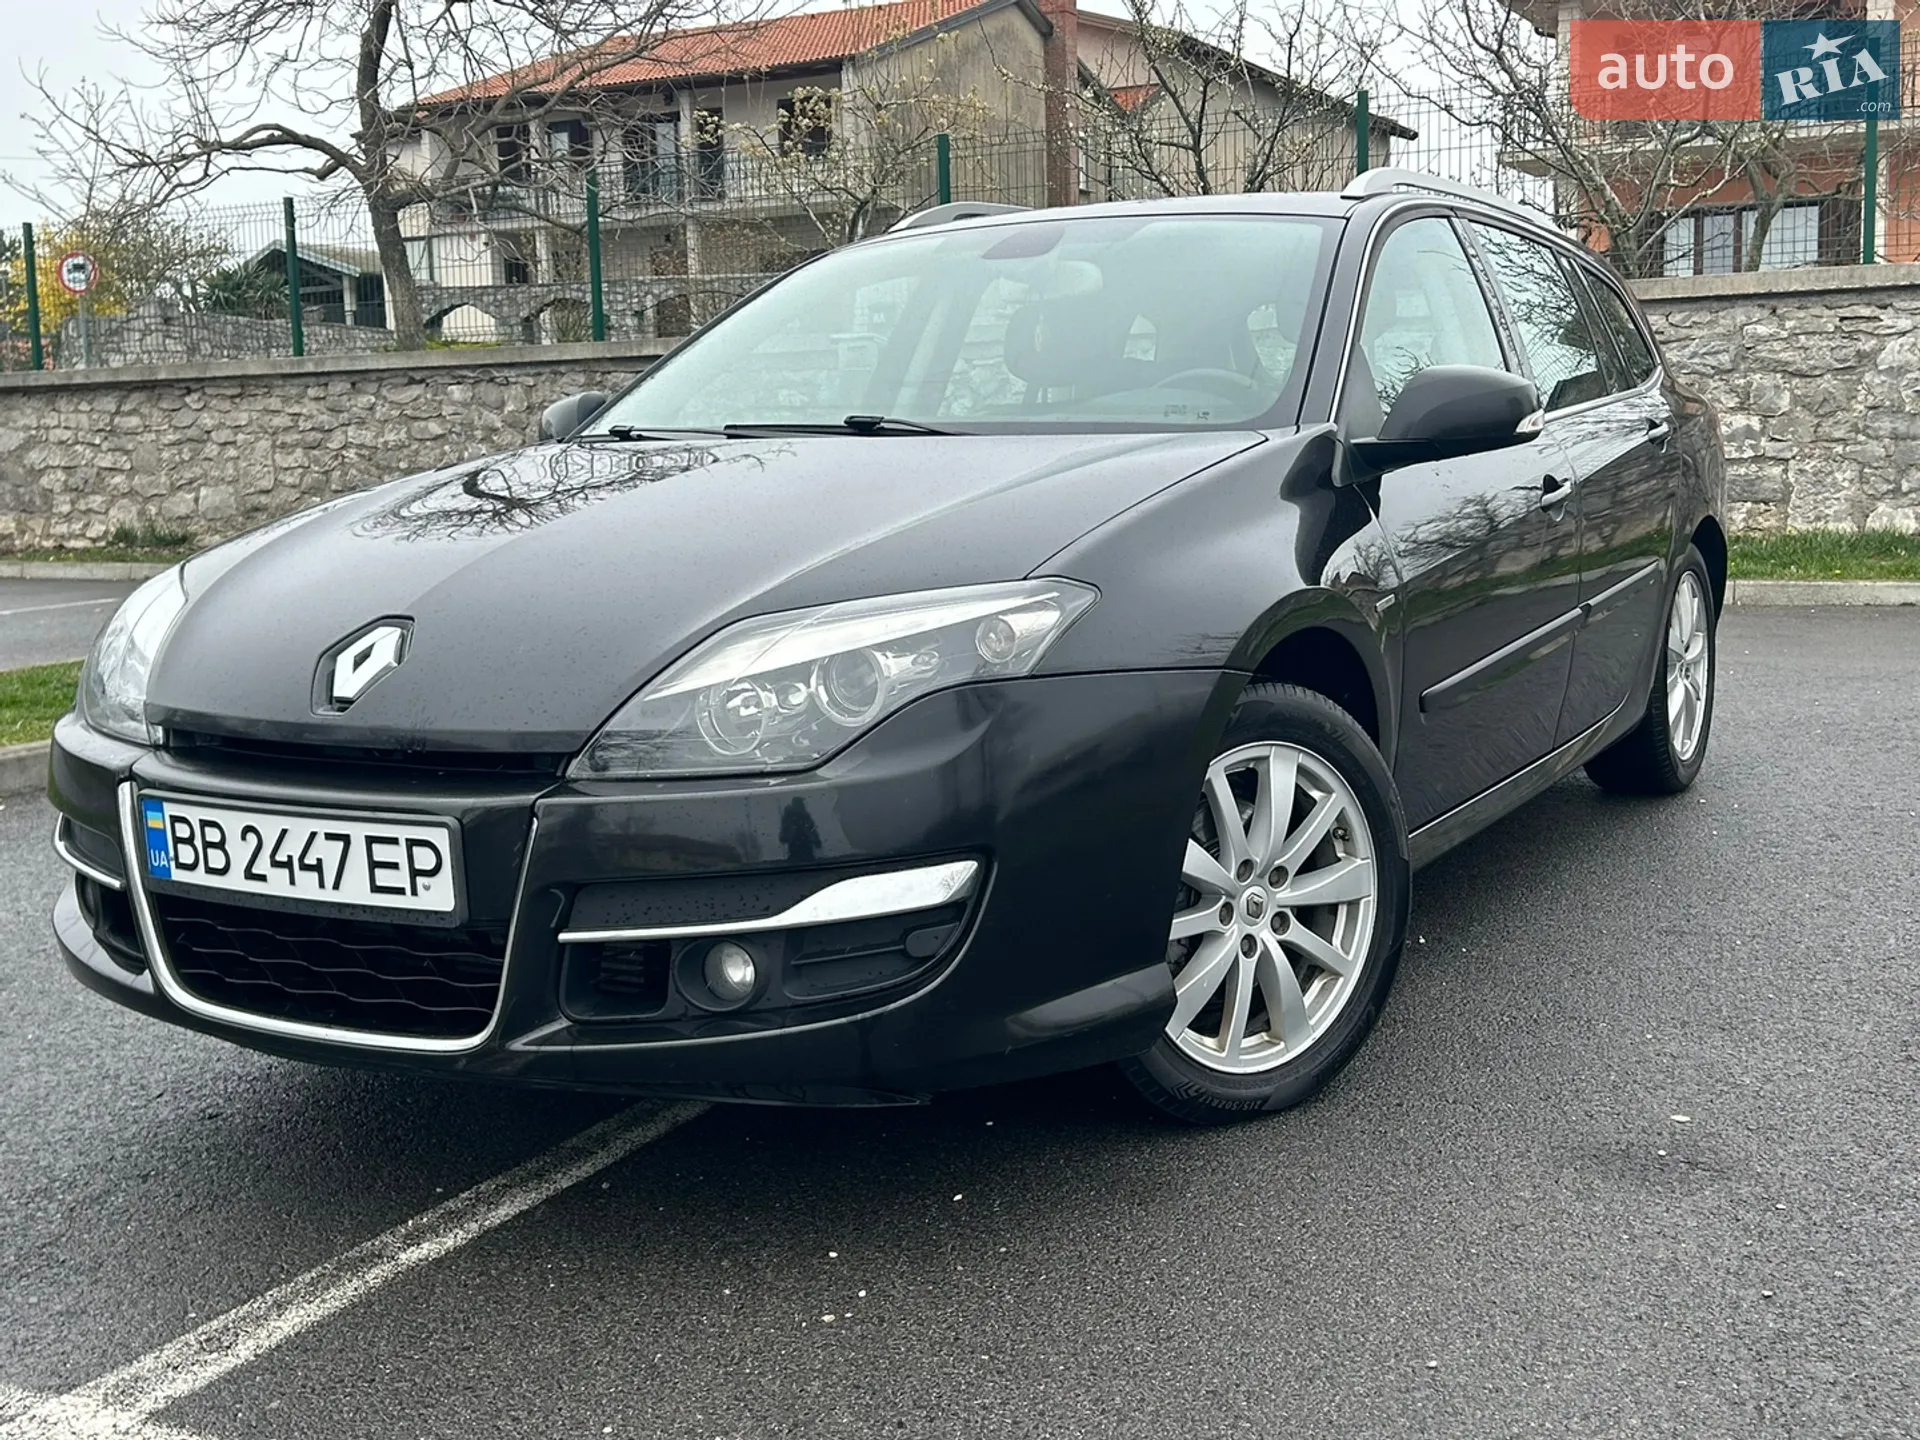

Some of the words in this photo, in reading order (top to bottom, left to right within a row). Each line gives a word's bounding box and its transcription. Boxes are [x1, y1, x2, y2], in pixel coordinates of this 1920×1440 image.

[150, 849, 168, 867] UA
[169, 815, 231, 876] BB
[240, 824, 351, 890] 2447
[364, 835, 443, 896] EP
